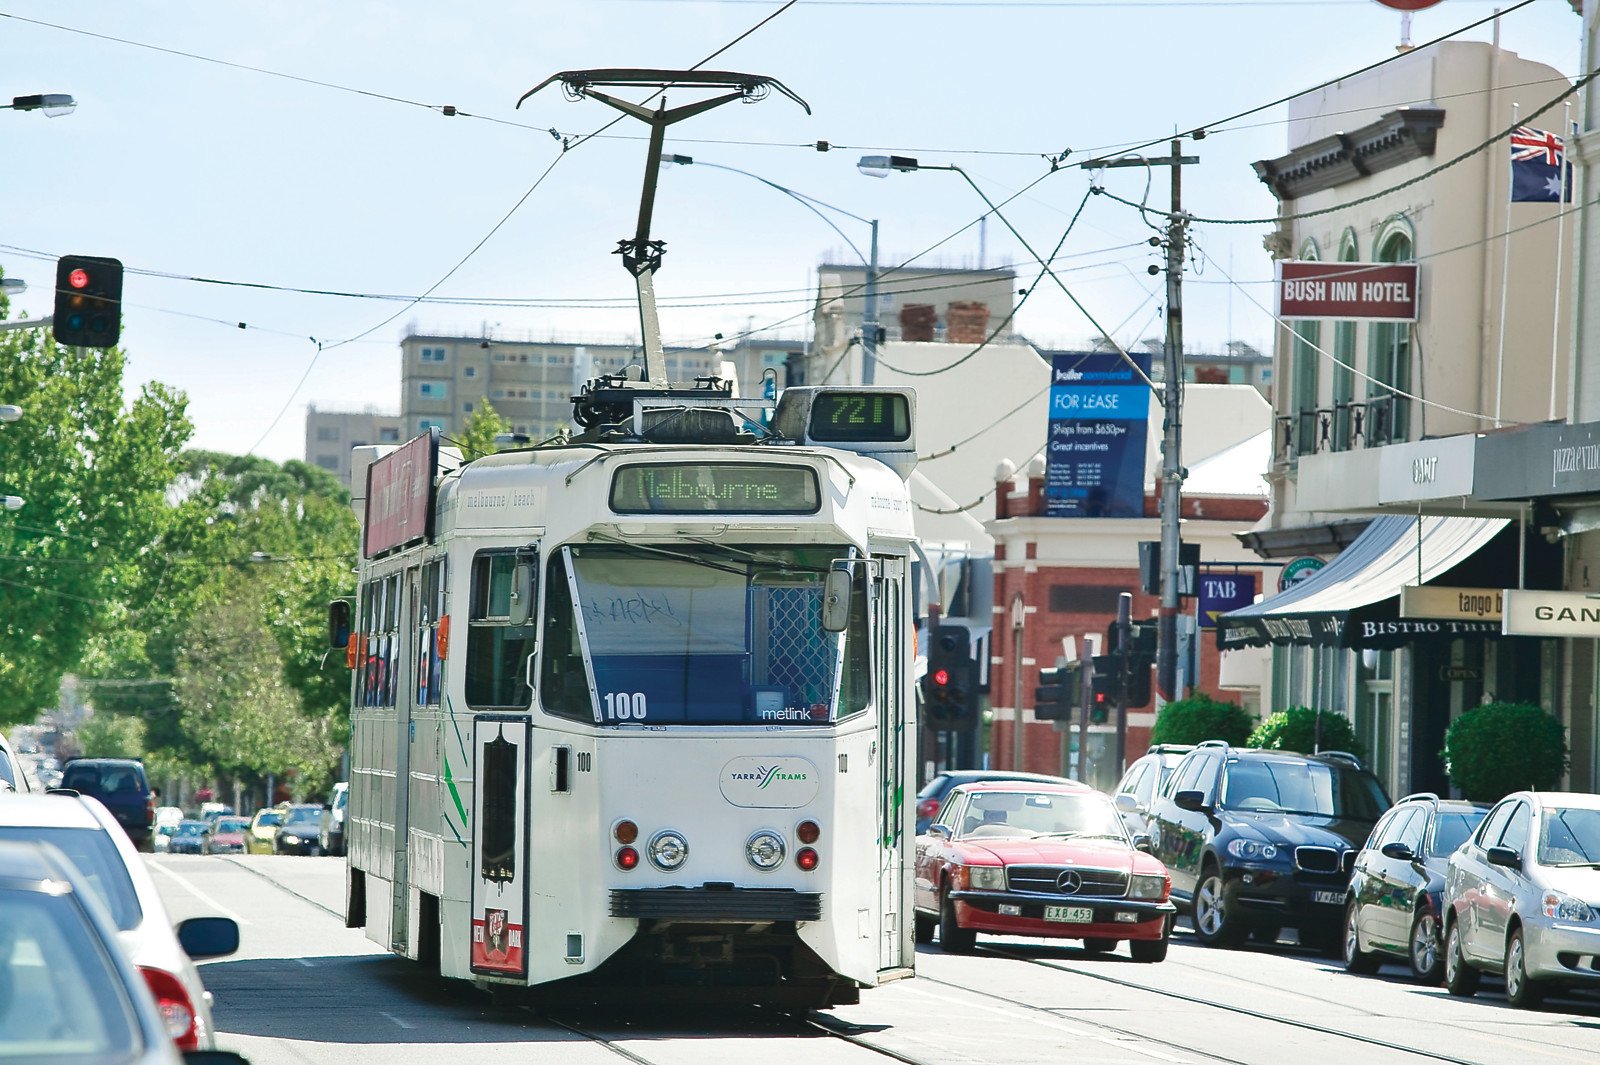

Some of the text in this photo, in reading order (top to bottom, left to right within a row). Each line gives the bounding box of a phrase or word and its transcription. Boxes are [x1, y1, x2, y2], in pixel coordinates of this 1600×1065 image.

[1284, 280, 1411, 302] BUSH INN HOTEL
[1055, 394, 1119, 409] FOR LEASE
[1053, 422, 1075, 437] Shops
[1076, 422, 1093, 434] from
[1051, 440, 1109, 451] Great incentives
[638, 469, 779, 500] Melbourne
[467, 490, 506, 509] melbourne
[514, 489, 535, 507] beach
[1205, 580, 1236, 599] TAB
[1459, 592, 1491, 616] tango
[1362, 621, 1440, 637] BISTRO
[604, 692, 647, 720] 100
[762, 707, 811, 720] metlink
[577, 752, 591, 773] 100
